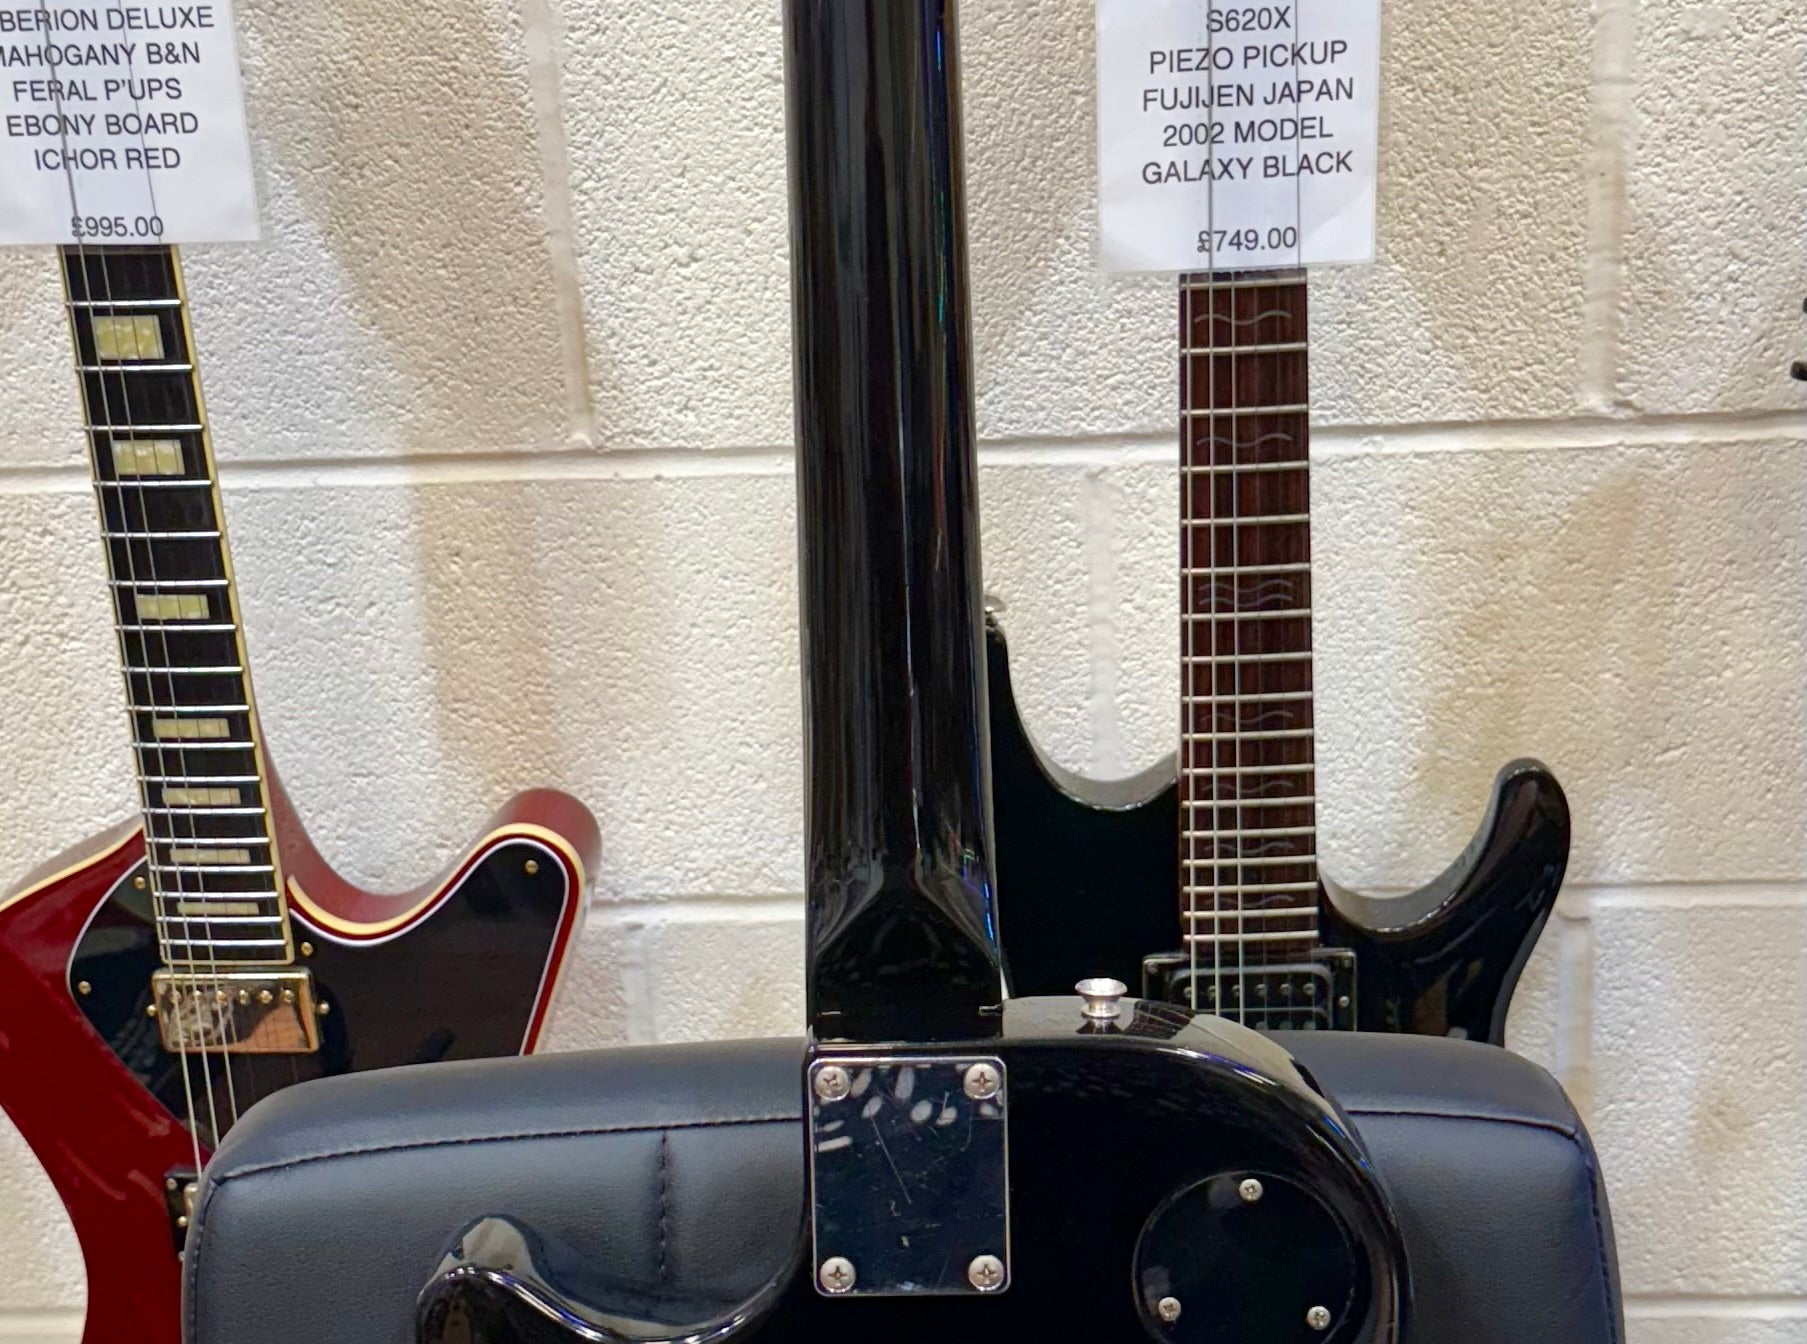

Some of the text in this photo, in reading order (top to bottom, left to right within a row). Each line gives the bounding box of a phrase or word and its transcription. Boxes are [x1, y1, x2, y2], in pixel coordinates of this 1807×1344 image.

[106, 6, 215, 30] DELUXE
[1206, 6, 1291, 33] S620X
[146, 41, 201, 64] B&N
[1150, 40, 1347, 74] PIEZO PICKUP
[13, 78, 182, 102] FERAL P'UPS
[1143, 77, 1353, 112] FUJIJEN JAPAN
[6, 112, 199, 136] EBONY BOARD
[1163, 116, 1333, 147] 2002 MODEL
[34, 147, 181, 170] ICHOR RED
[1142, 150, 1353, 184] GALAXY BLACK
[71, 216, 163, 237] £995.00
[1197, 226, 1297, 253] £749.00
